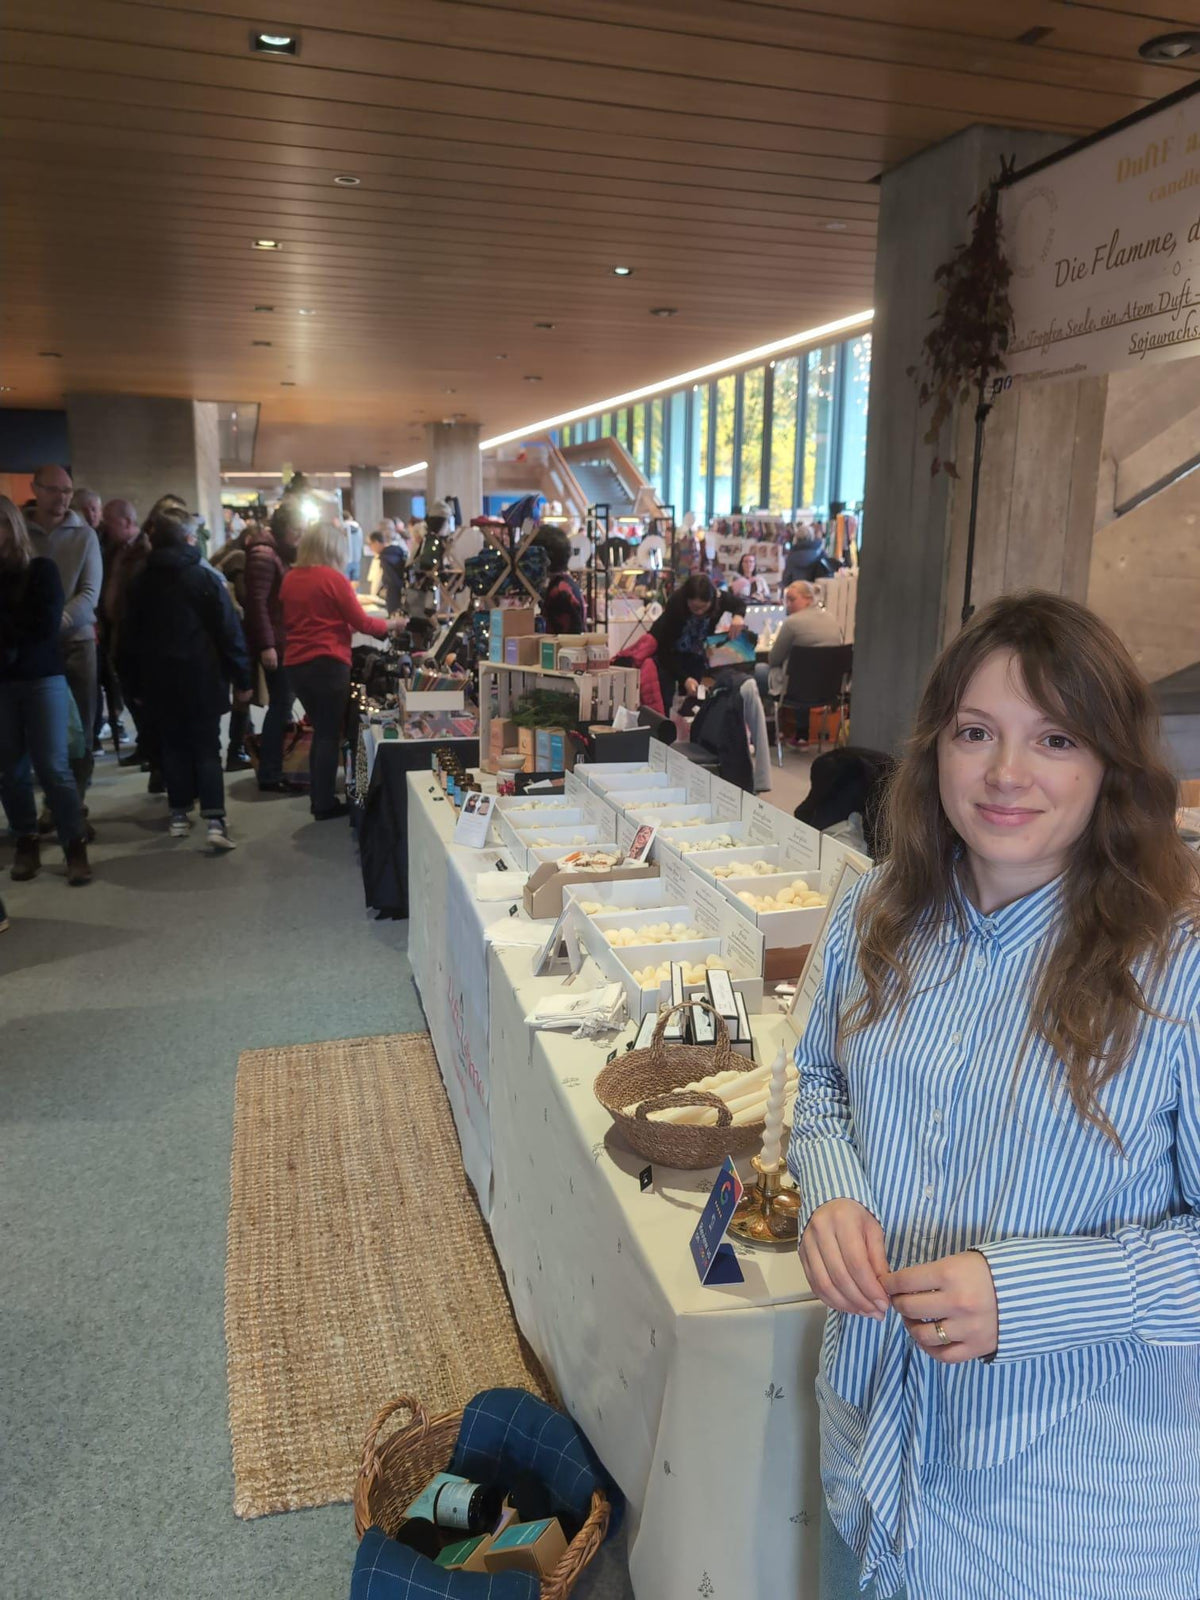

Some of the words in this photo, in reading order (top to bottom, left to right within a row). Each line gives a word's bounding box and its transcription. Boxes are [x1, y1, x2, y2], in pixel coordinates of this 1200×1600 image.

[1055, 257, 1088, 288] Die
[1091, 228, 1177, 275] Flamme,
[1100, 309, 1118, 328] ein
[1119, 300, 1155, 322] Atem
[1158, 278, 1192, 322] Duft
[1128, 309, 1200, 361] Sojawachs
